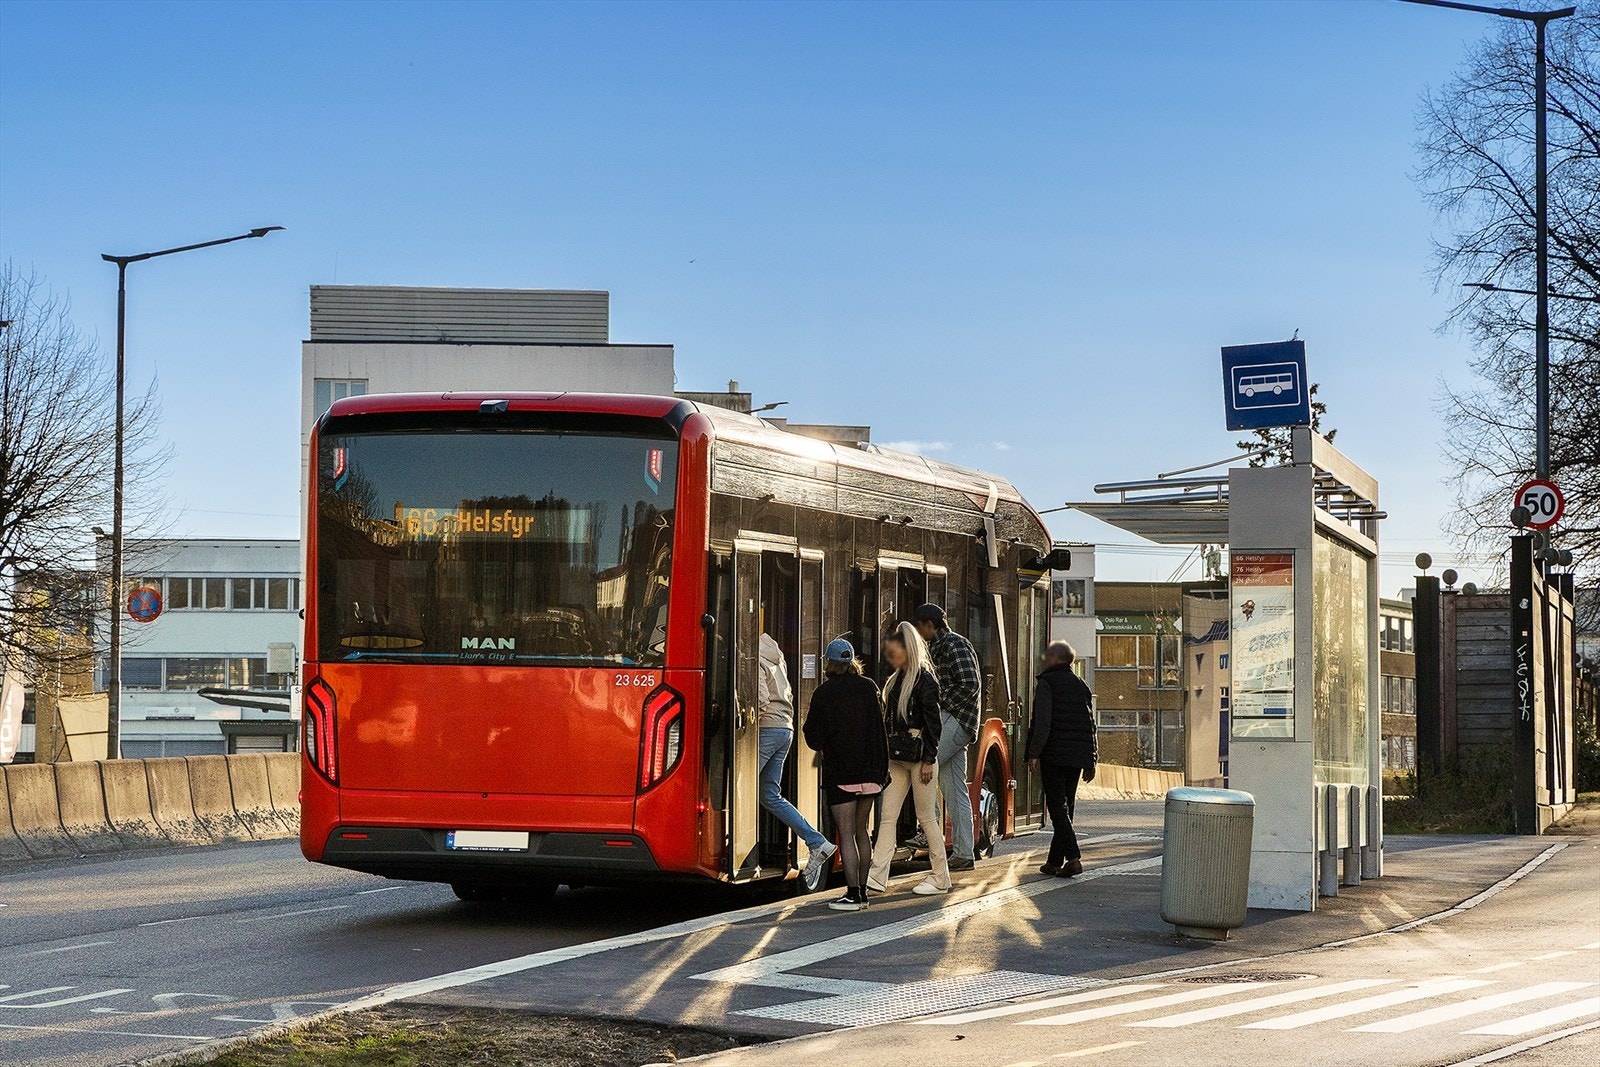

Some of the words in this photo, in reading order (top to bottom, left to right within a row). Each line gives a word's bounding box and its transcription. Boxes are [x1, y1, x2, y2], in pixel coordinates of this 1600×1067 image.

[1524, 492, 1556, 516] 50
[407, 508, 437, 537] 66
[458, 509, 535, 538] Helsfyr
[461, 637, 515, 650] MAN
[488, 652, 506, 661] City
[615, 674, 630, 686] 23
[633, 674, 655, 687] 625
